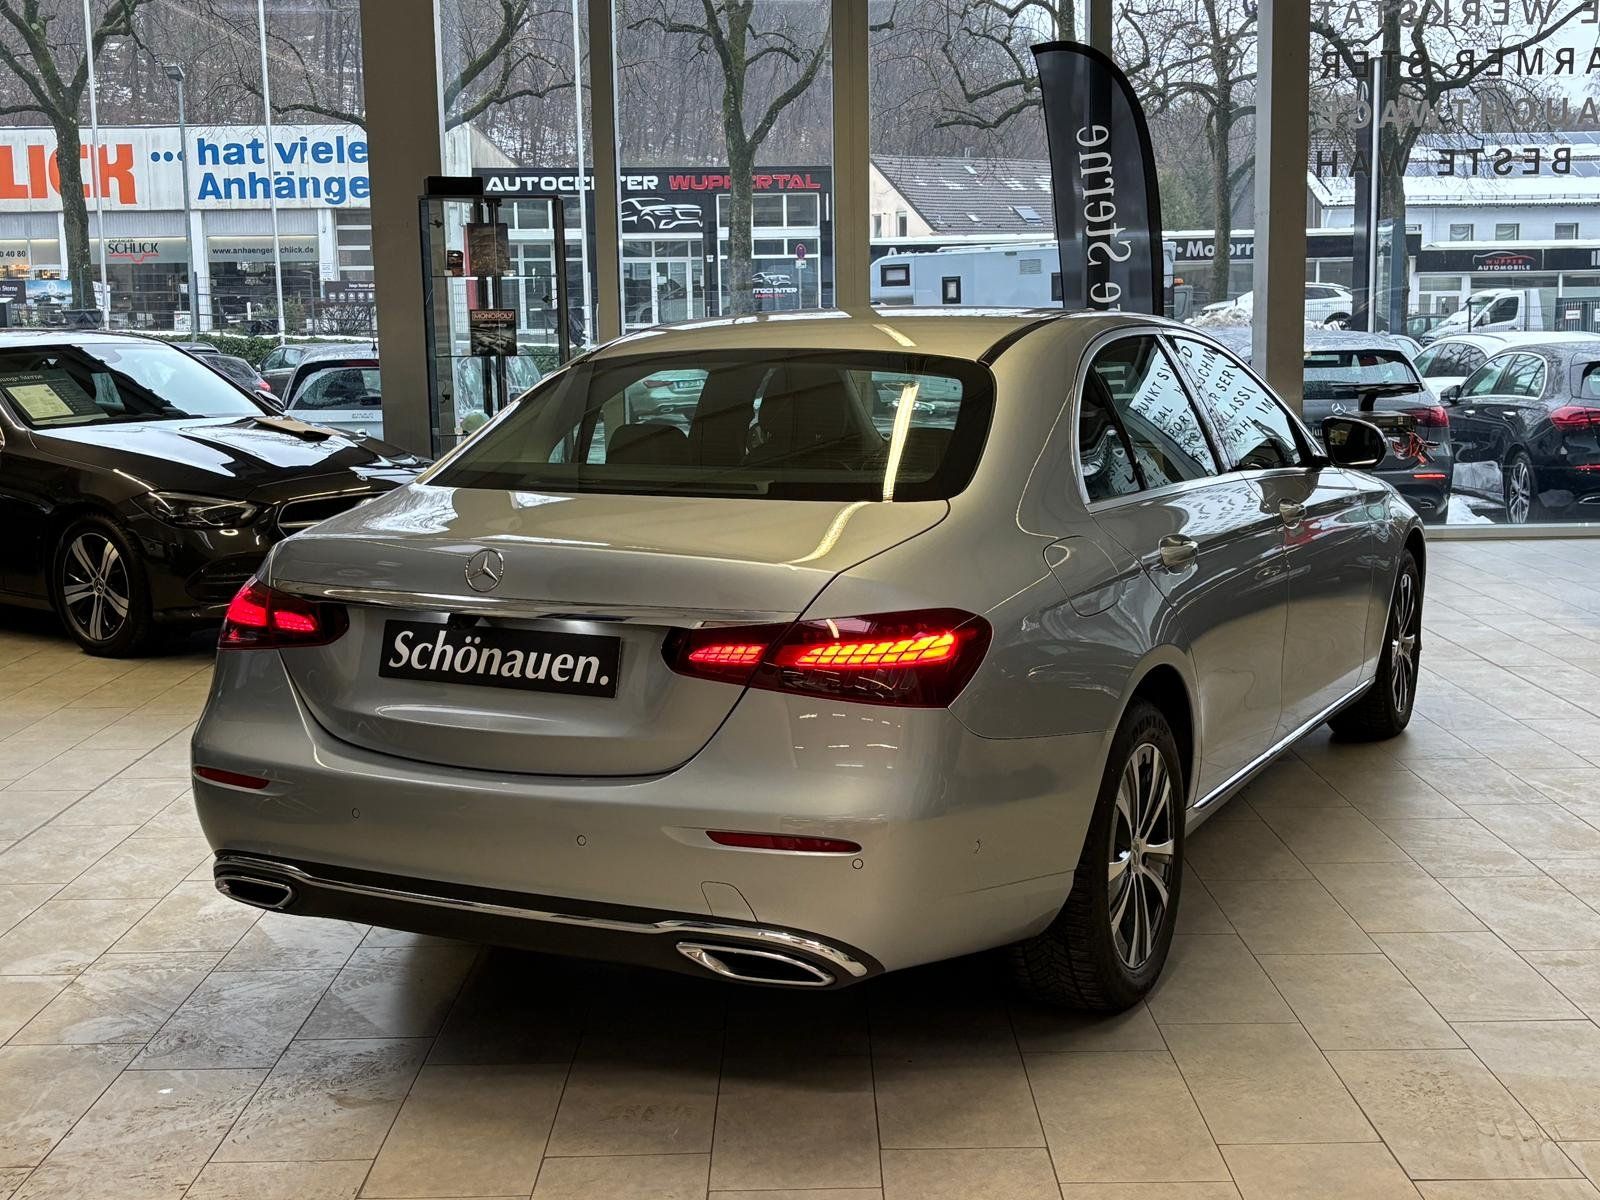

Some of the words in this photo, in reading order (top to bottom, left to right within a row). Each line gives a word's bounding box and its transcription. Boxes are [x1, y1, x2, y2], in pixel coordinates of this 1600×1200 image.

[197, 138, 265, 166] hat
[274, 136, 369, 164] viele
[485, 175, 659, 192] AUTOCEER
[108, 242, 160, 255] SCHLICK
[212, 246, 314, 255] www.anhaengerchlick.de
[473, 311, 514, 321] MONOPOLY
[388, 630, 610, 686] Schönauen.
